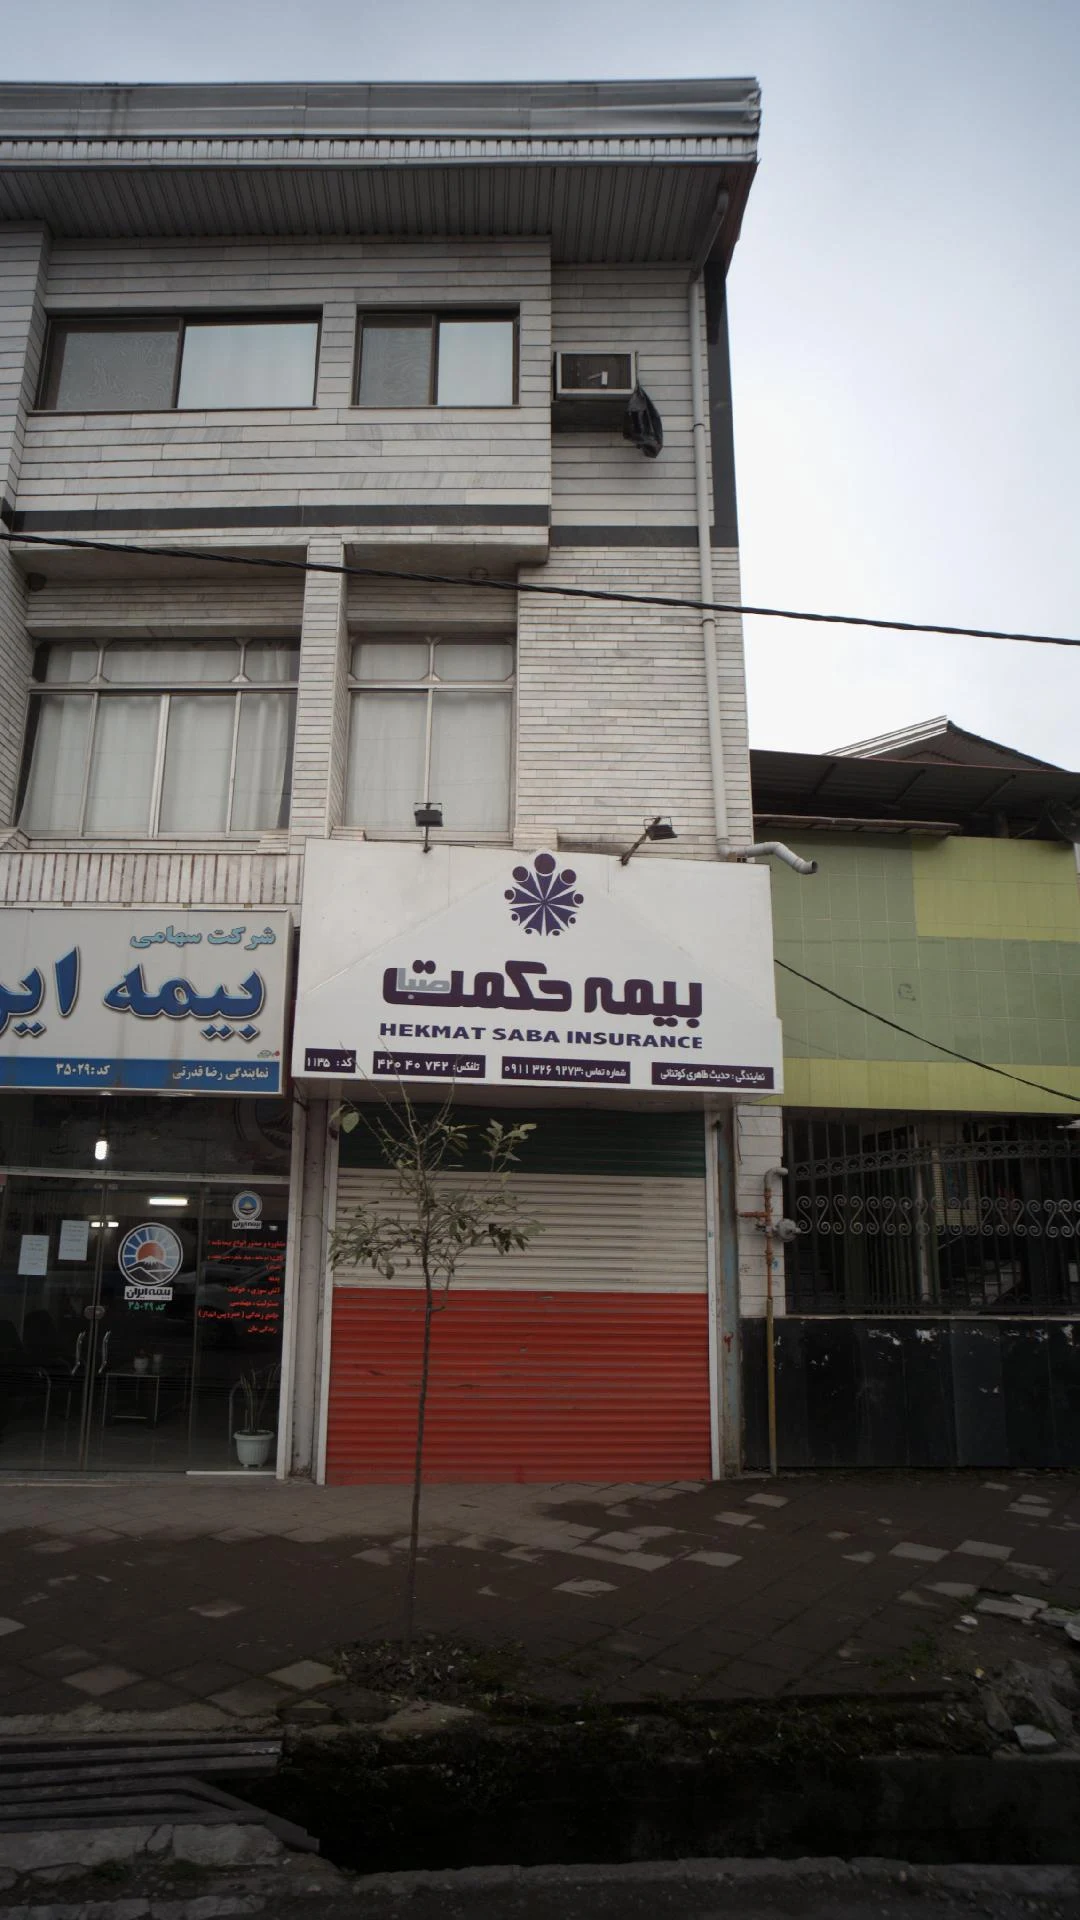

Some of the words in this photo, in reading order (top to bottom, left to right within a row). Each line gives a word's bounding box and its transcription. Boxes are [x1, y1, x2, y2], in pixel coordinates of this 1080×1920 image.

[130, 925, 202, 948] سهامی
[207, 927, 276, 950] شرکت
[383, 959, 572, 1013] حکمت
[103, 962, 265, 1041] بیمه
[584, 976, 703, 1029] بیمه
[379, 1022, 487, 1041] HEKMAT
[492, 1027, 560, 1044] SABA
[566, 1031, 704, 1050] INSURANCE
[173, 1066, 203, 1080] قدرتی
[206, 1066, 223, 1080] رضا
[225, 1067, 269, 1080] نمایندگی
[504, 1064, 528, 1074] ۰۹۱۱
[606, 1068, 626, 1078] شماره
[687, 1070, 708, 1080] طاهری
[709, 1071, 730, 1081] حدیث
[126, 1288, 148, 1298] ایران
[148, 1289, 170, 1299] بیمه
